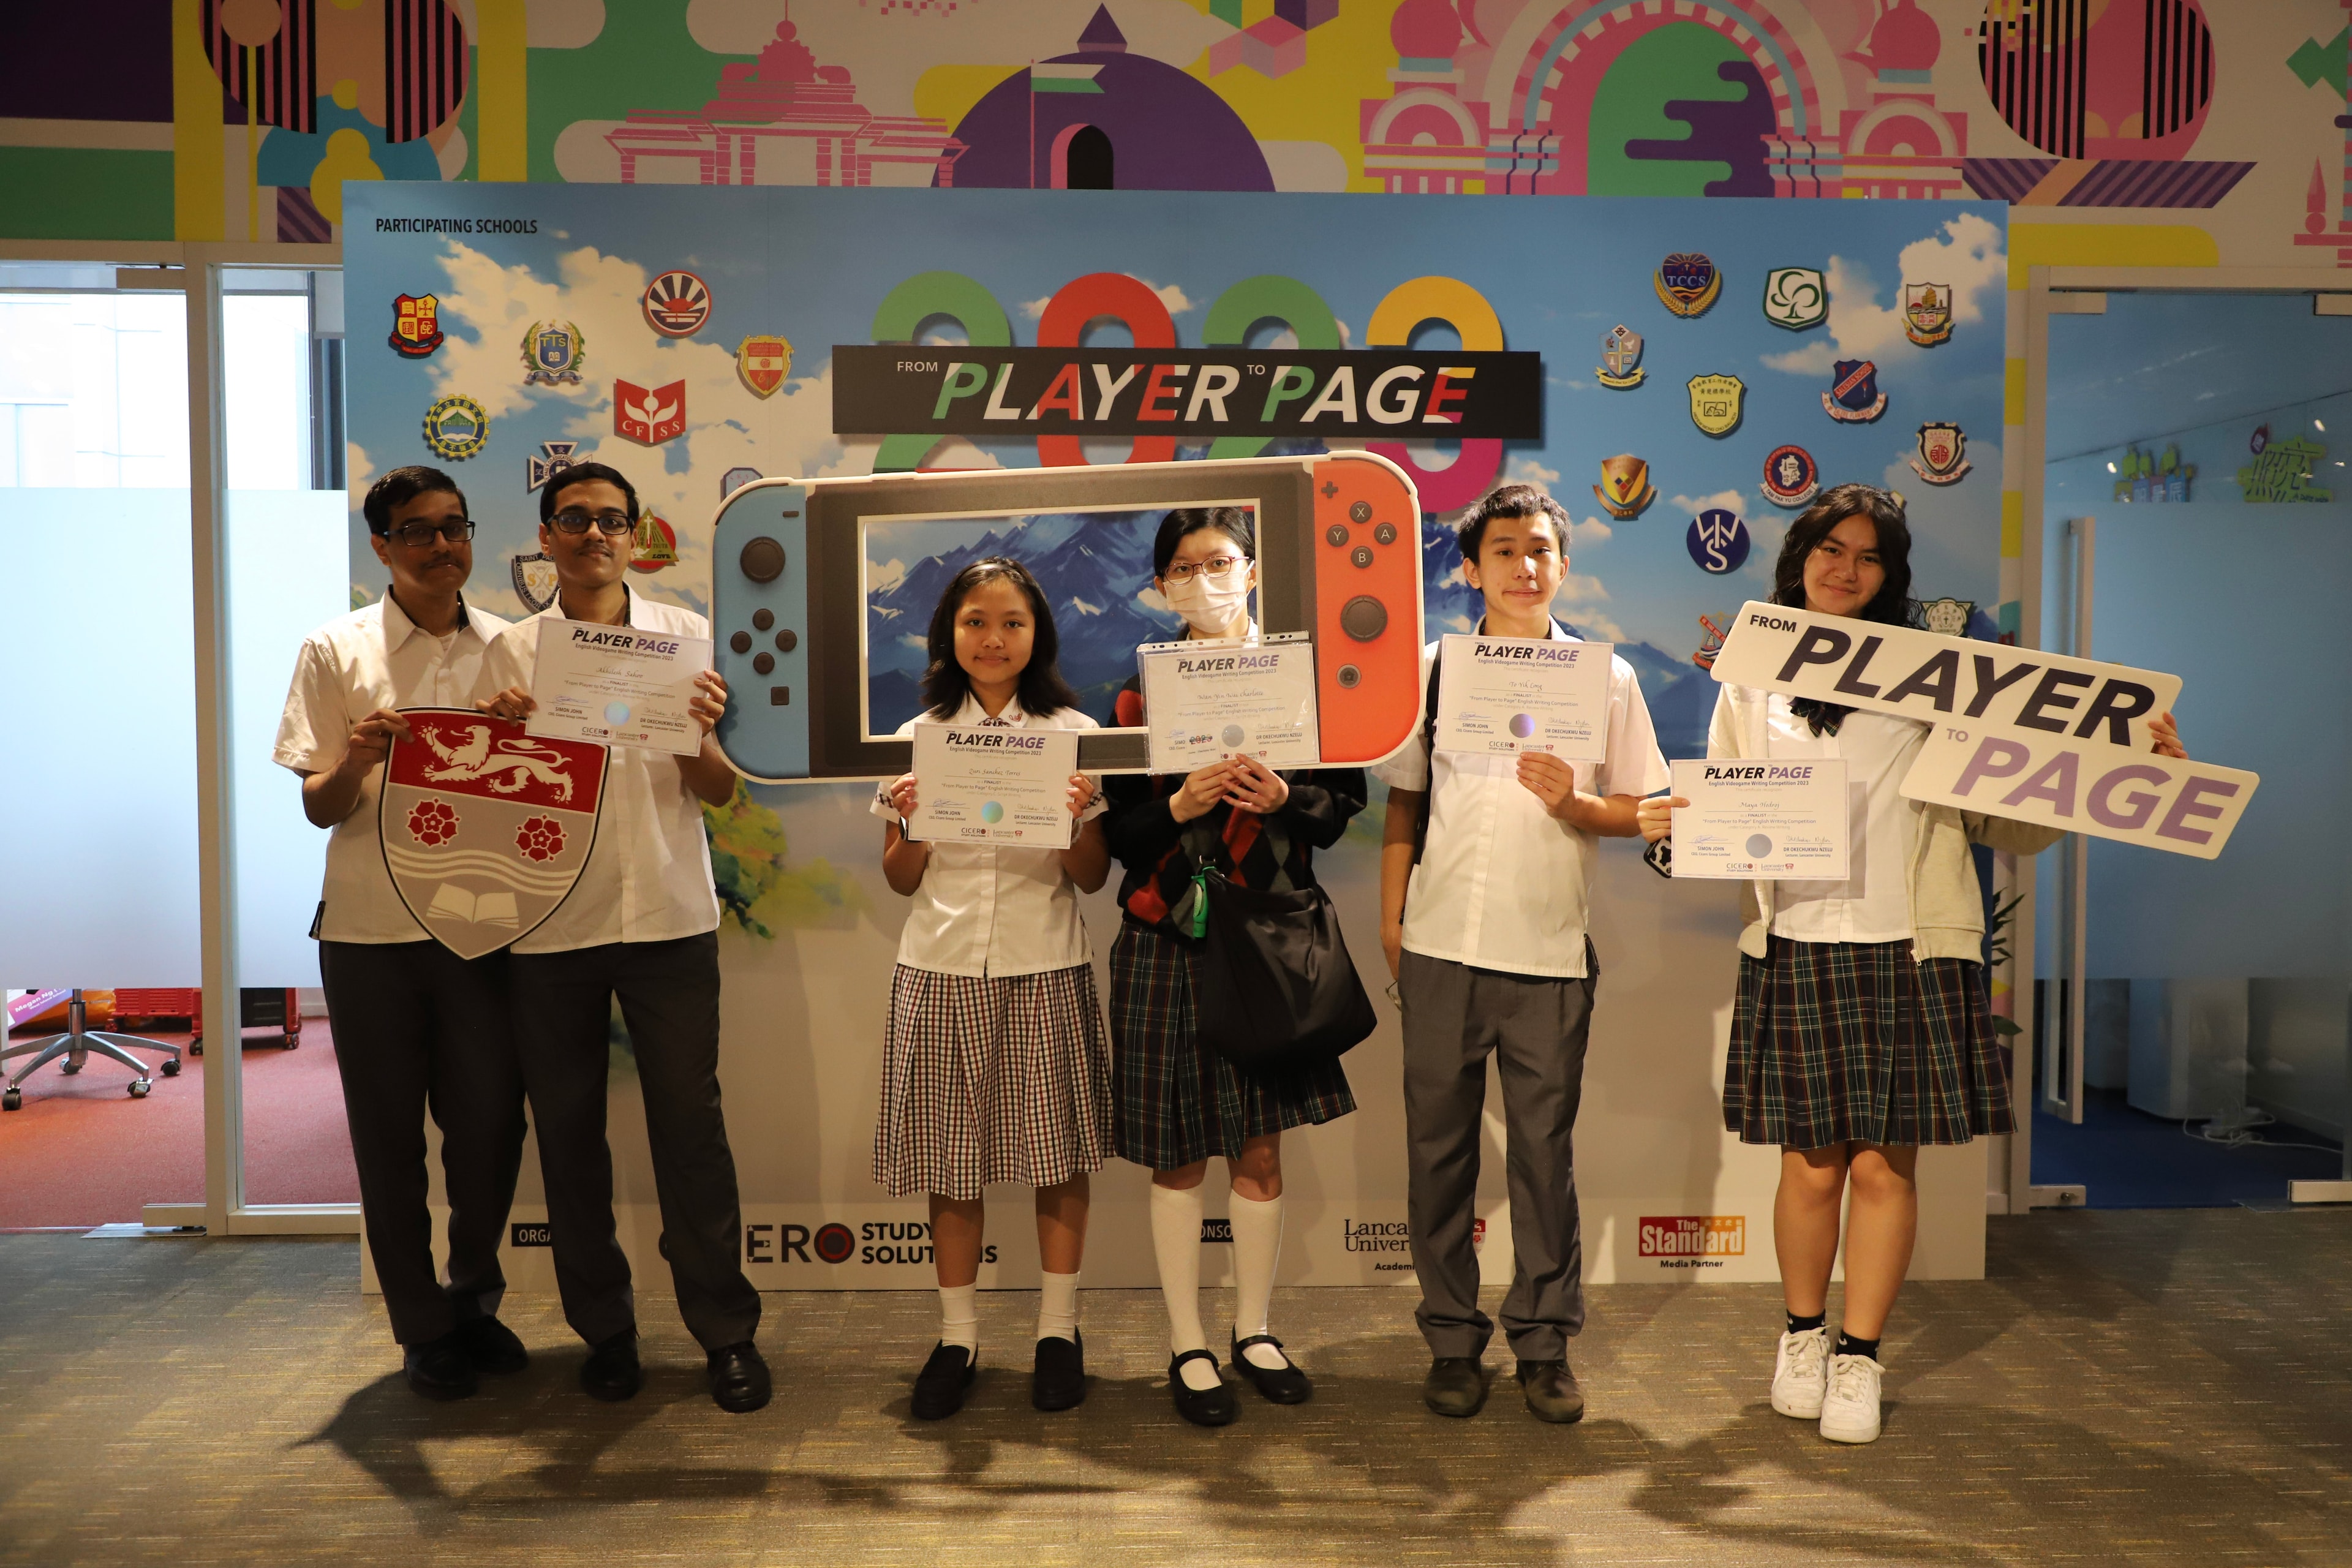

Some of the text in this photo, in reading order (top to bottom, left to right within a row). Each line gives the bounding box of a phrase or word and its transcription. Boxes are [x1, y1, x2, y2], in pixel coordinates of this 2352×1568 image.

[376, 219, 538, 233] PARTICIPATING SCHOOLS
[1667, 276, 1706, 286] TCCS
[540, 334, 566, 347] TTS
[897, 361, 1476, 424] FROM PLAYER TO PAGE
[1357, 508, 1365, 518] X
[1333, 529, 1390, 540] Y A
[1359, 553, 1366, 562] B
[1750, 614, 1796, 633] FROM
[572, 629, 679, 655] PLAYER PAGE
[592, 646, 617, 654] Videogame
[635, 651, 661, 660] Competition
[1474, 644, 1579, 662] PLAYER PAGE
[1177, 655, 1280, 673] PLAYER PAGE
[1776, 625, 2155, 747] PLAYER
[946, 733, 1046, 749] PLAYER PAGE
[1947, 728, 1968, 742] TO
[1705, 767, 1813, 779] PLAYER PAGE
[1950, 736, 2241, 845] PAGE
[15, 989, 53, 1012] Megan Ng
[1344, 1219, 1409, 1236] Lanca
[1676, 1219, 1698, 1231] The
[519, 1229, 551, 1243] ORGA
[1344, 1235, 1410, 1252] Univer
[1642, 1225, 1742, 1254] Standard
